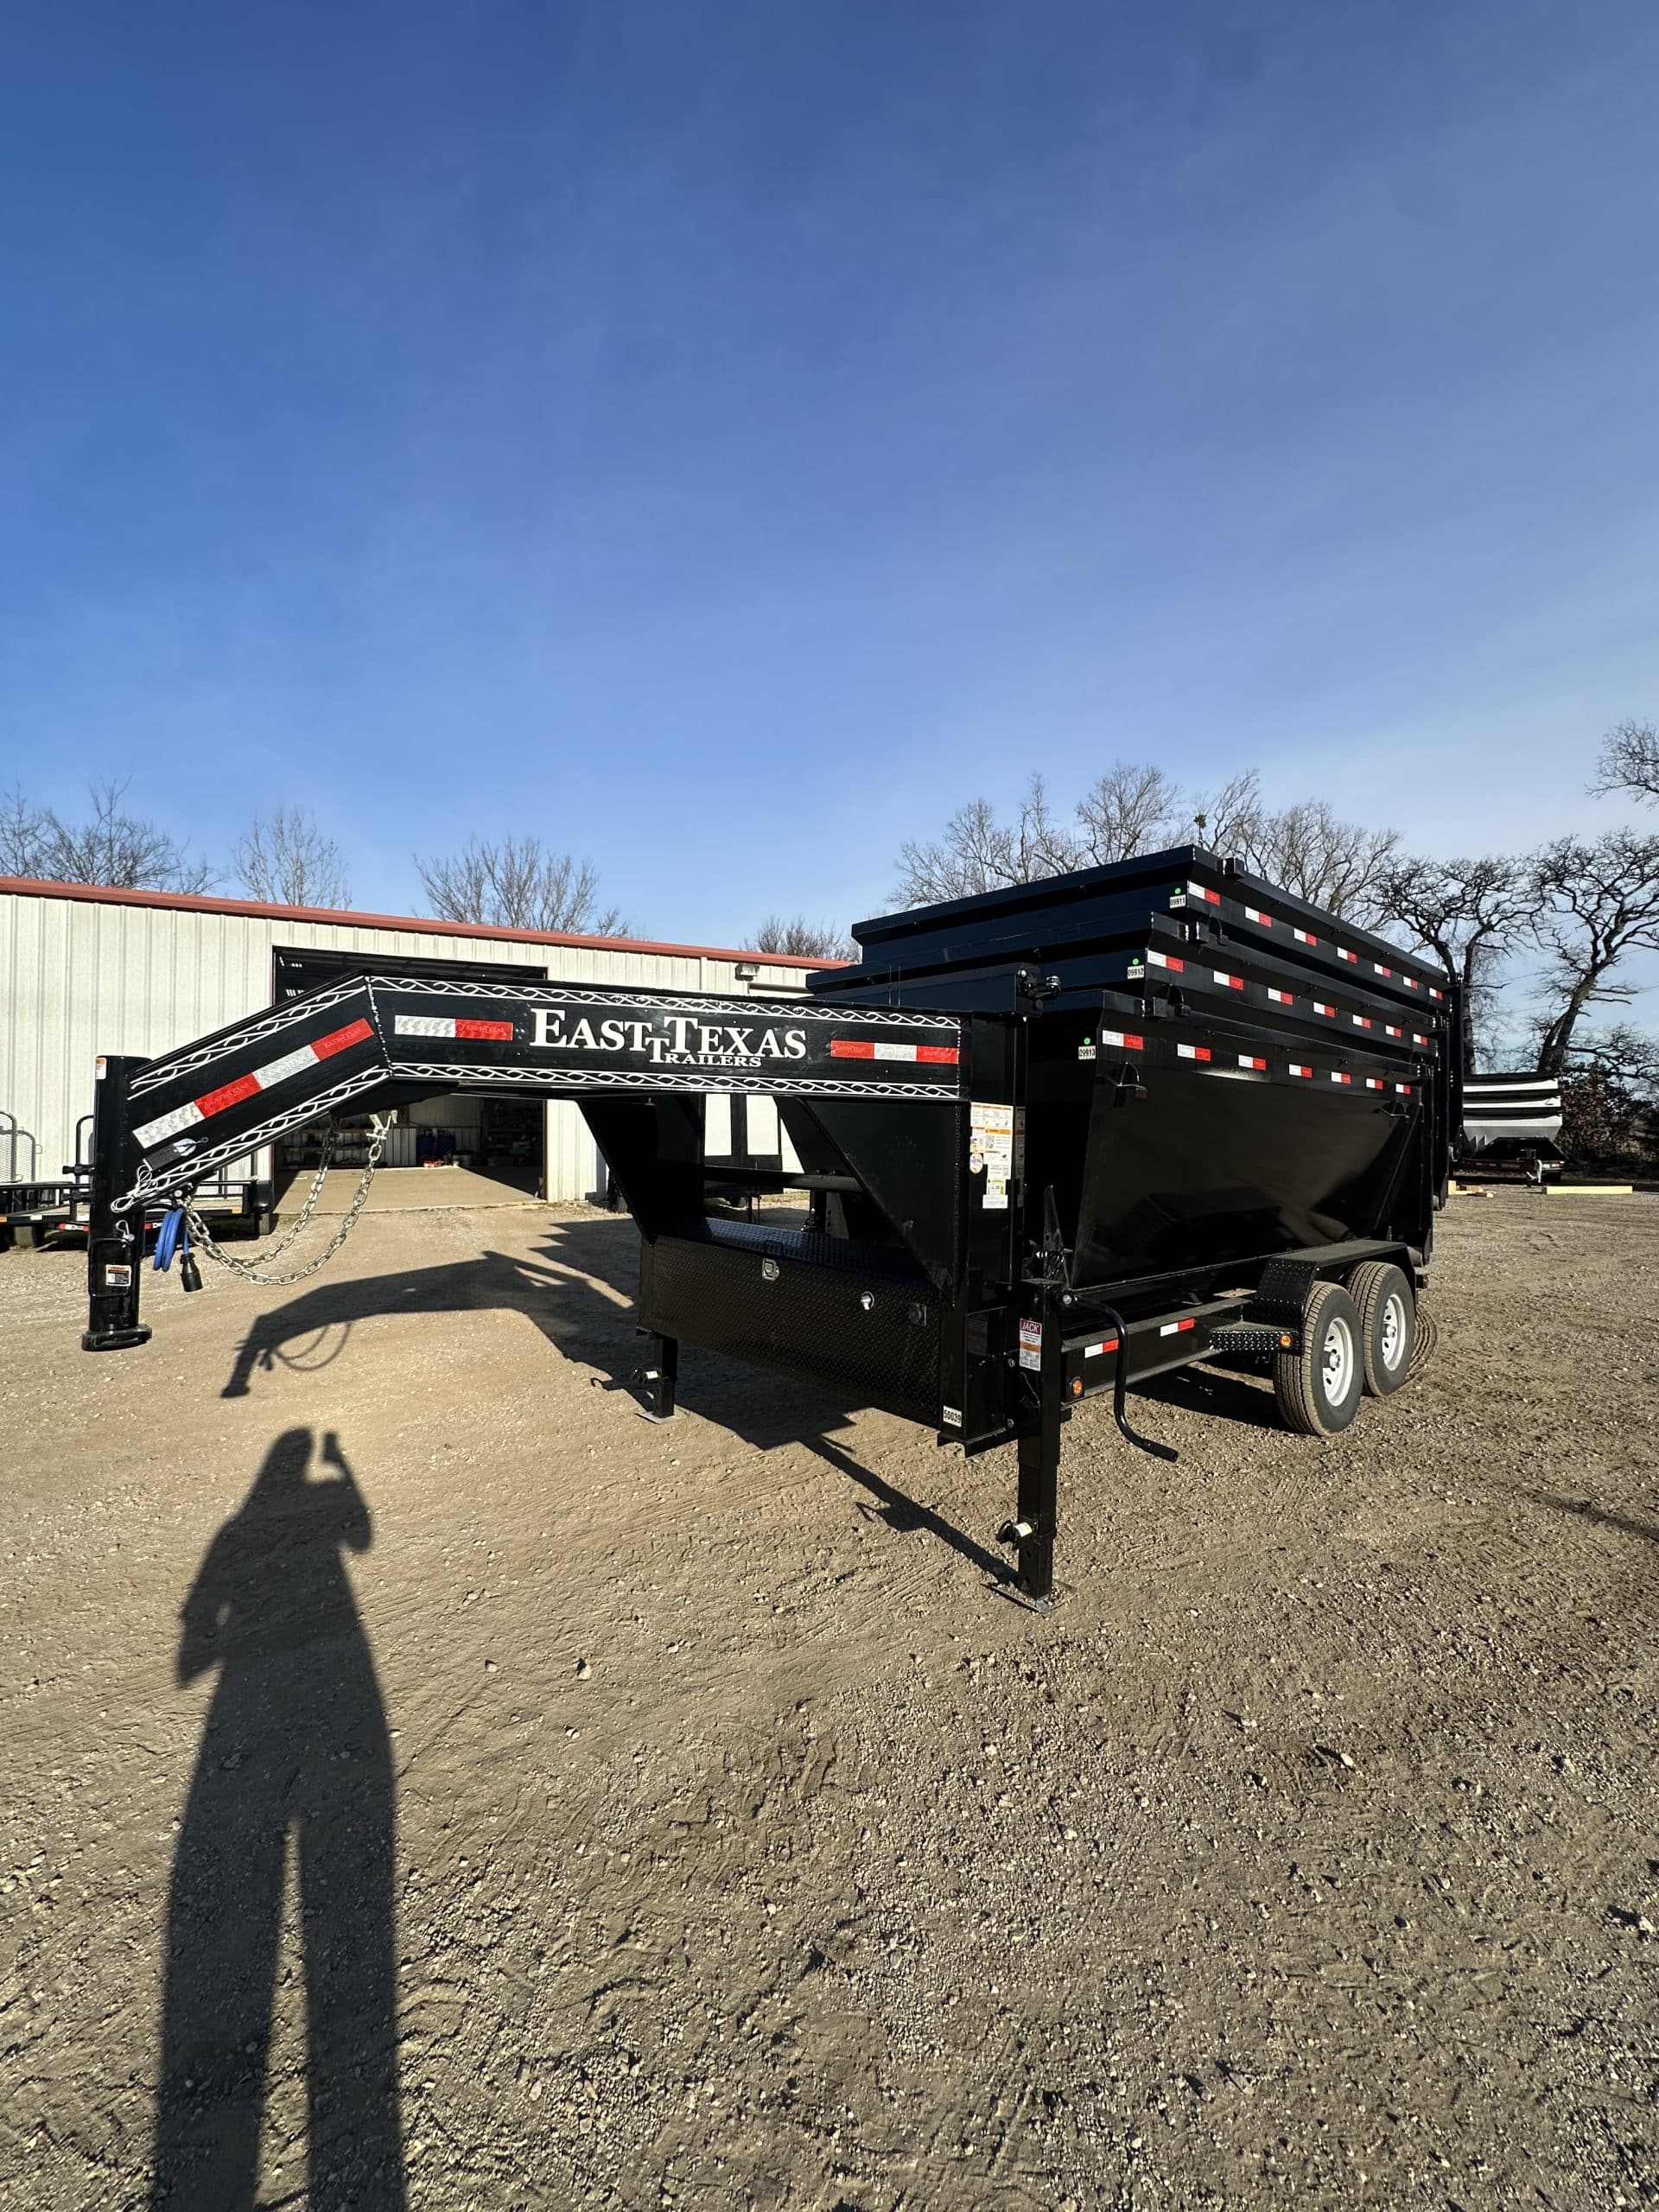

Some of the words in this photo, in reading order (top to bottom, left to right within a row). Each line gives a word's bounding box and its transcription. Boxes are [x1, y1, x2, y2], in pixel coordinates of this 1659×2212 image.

[1128, 968, 1144, 976] 09912
[530, 1007, 652, 1052] EAST
[664, 1016, 806, 1059] TEXAS
[645, 1037, 762, 1067] TRAILERS
[1078, 1049, 1096, 1058] 09913
[1022, 1321, 1039, 1334] JACK
[944, 1409, 962, 1424] 50039
